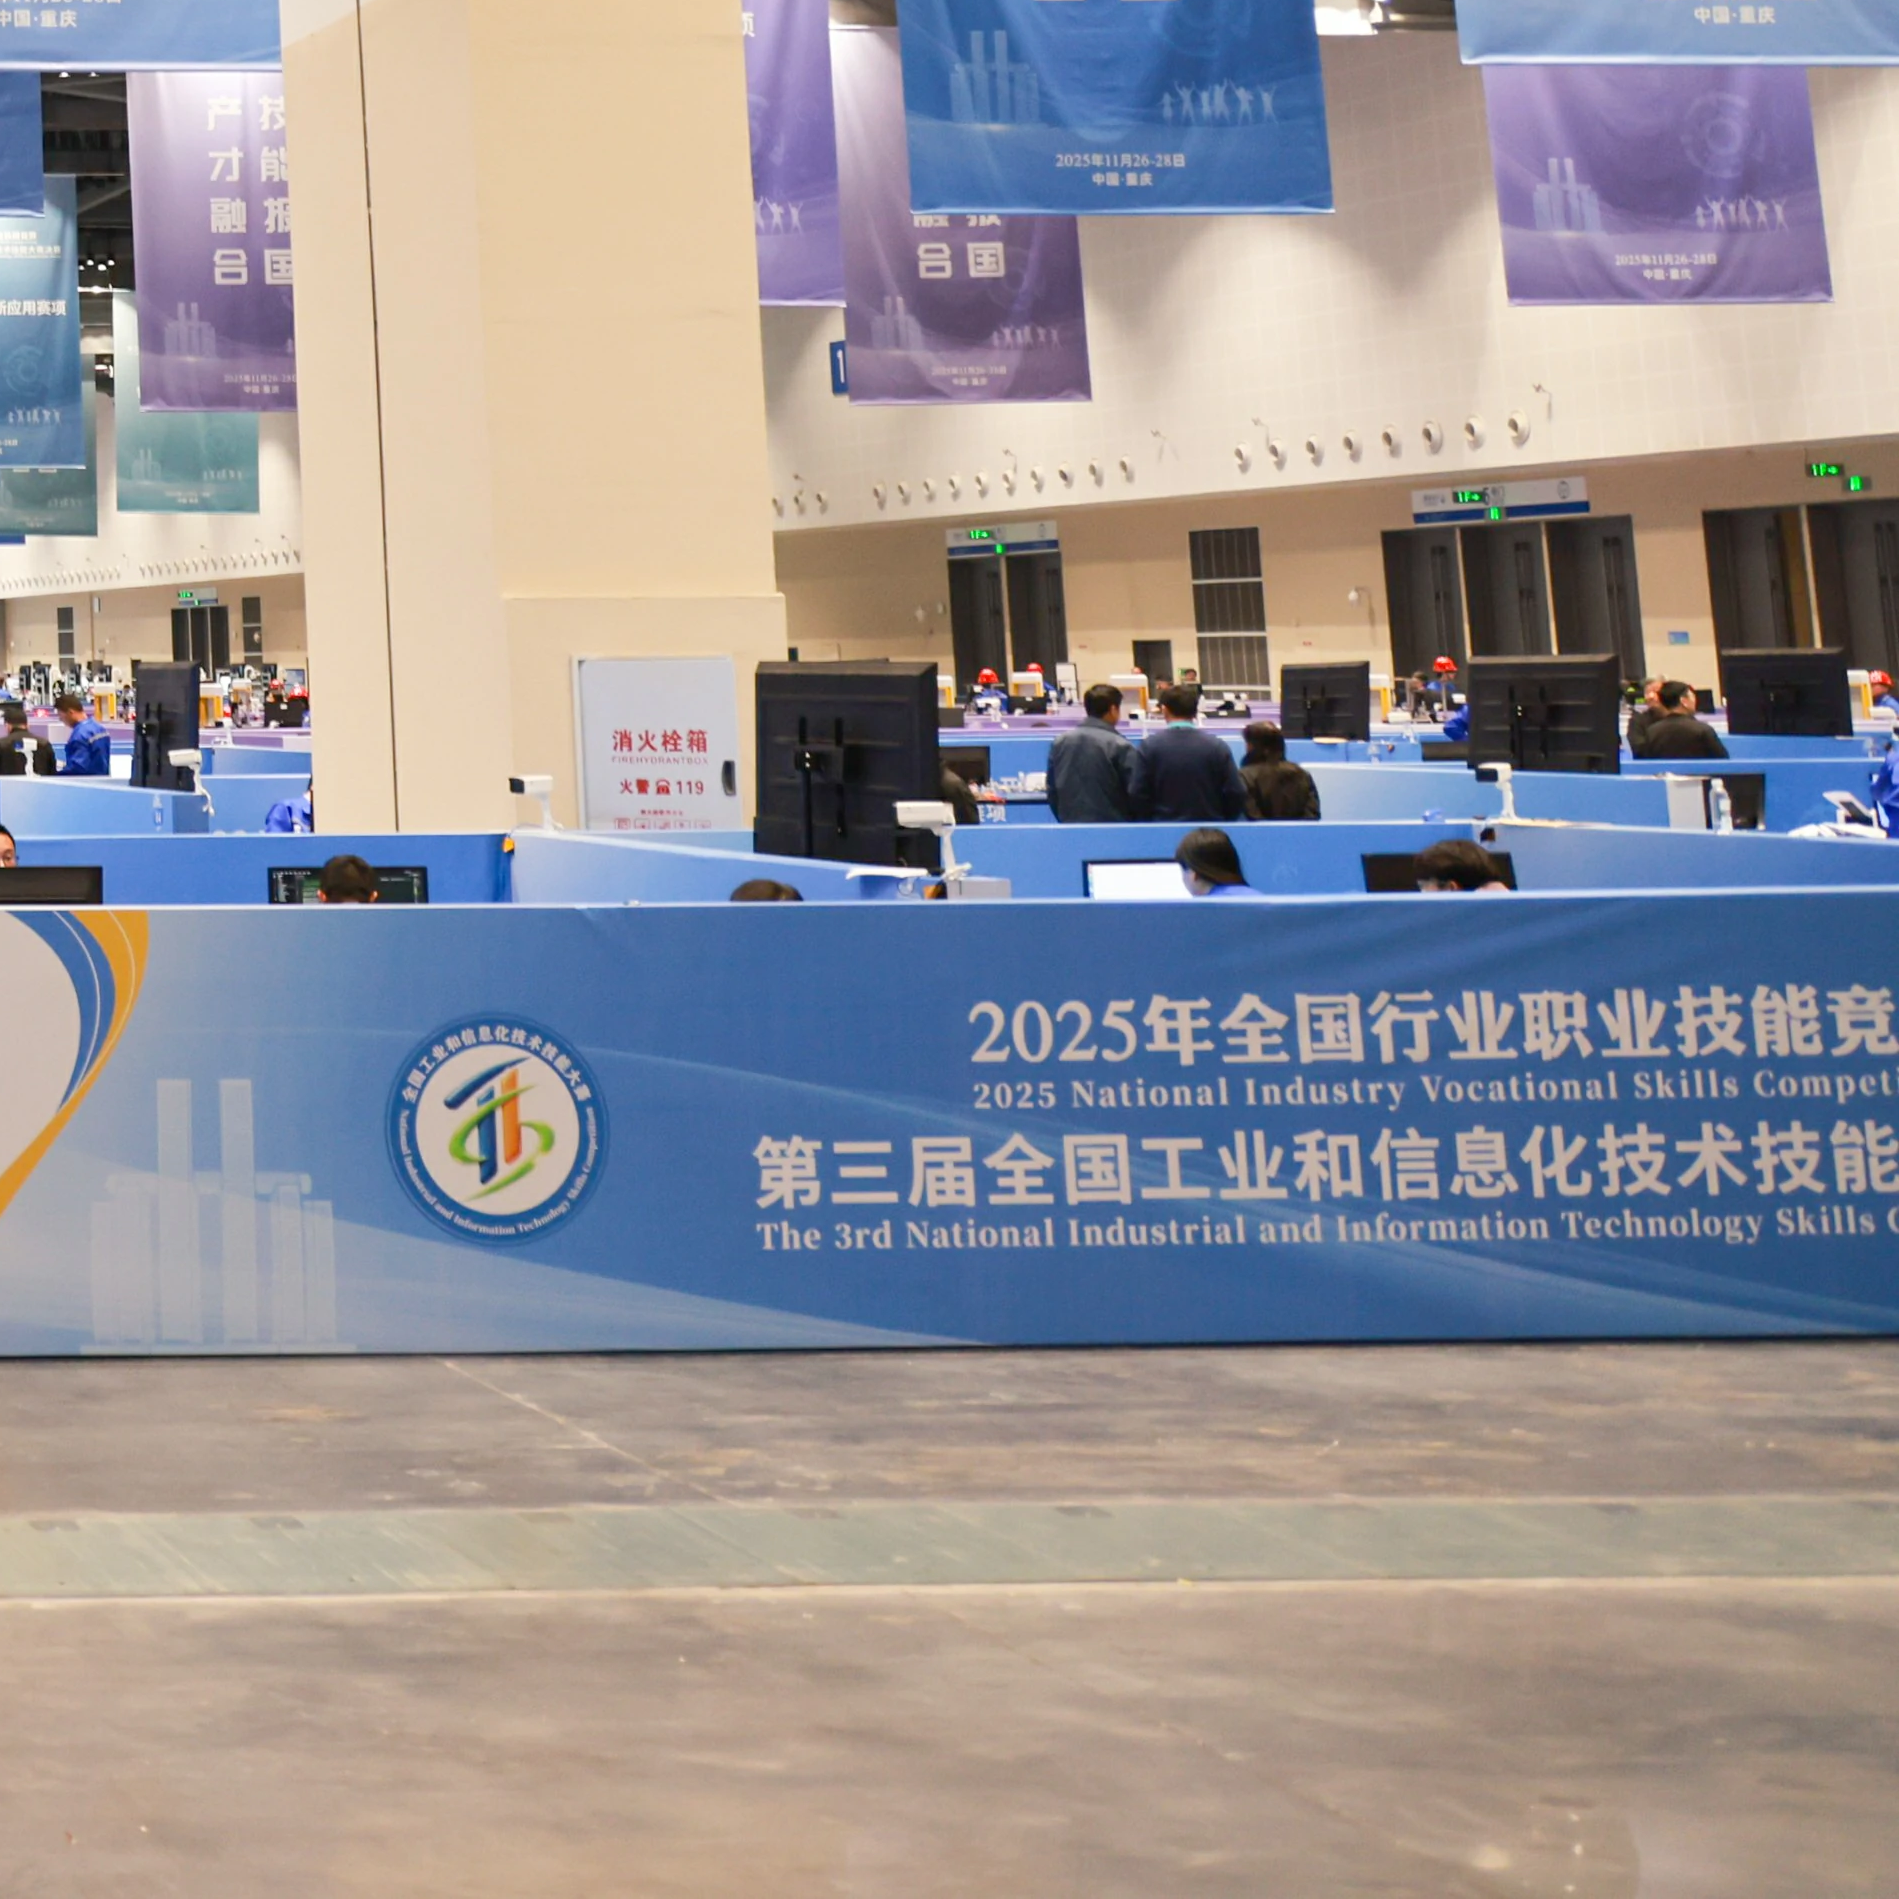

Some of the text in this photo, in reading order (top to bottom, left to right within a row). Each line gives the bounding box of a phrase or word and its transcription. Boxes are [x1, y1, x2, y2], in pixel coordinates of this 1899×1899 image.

[1055, 151, 1186, 170] 2025年11月26-28日
[206, 95, 248, 286] 产才融合
[612, 728, 708, 753] 消火栓箱
[676, 780, 704, 795] 119
[968, 983, 1899, 1067] 2025年全国行业职业技能竞
[973, 1080, 1057, 1110] 2025
[1071, 1076, 1229, 1109] National
[1244, 1074, 1405, 1111] Industry
[1421, 1070, 1618, 1104] Vocational
[1633, 1068, 1739, 1101] Skills
[752, 1118, 1899, 1210] 第三届全国工业和信息化技术技能
[756, 1221, 821, 1251] The
[834, 1219, 893, 1251] 3rd
[905, 1218, 1056, 1249] National
[1068, 1214, 1247, 1248] Industrial
[1259, 1214, 1322, 1244] and
[1336, 1211, 1550, 1244] Information
[1560, 1207, 1763, 1245] Technology
[1776, 1204, 1876, 1236] Skills
